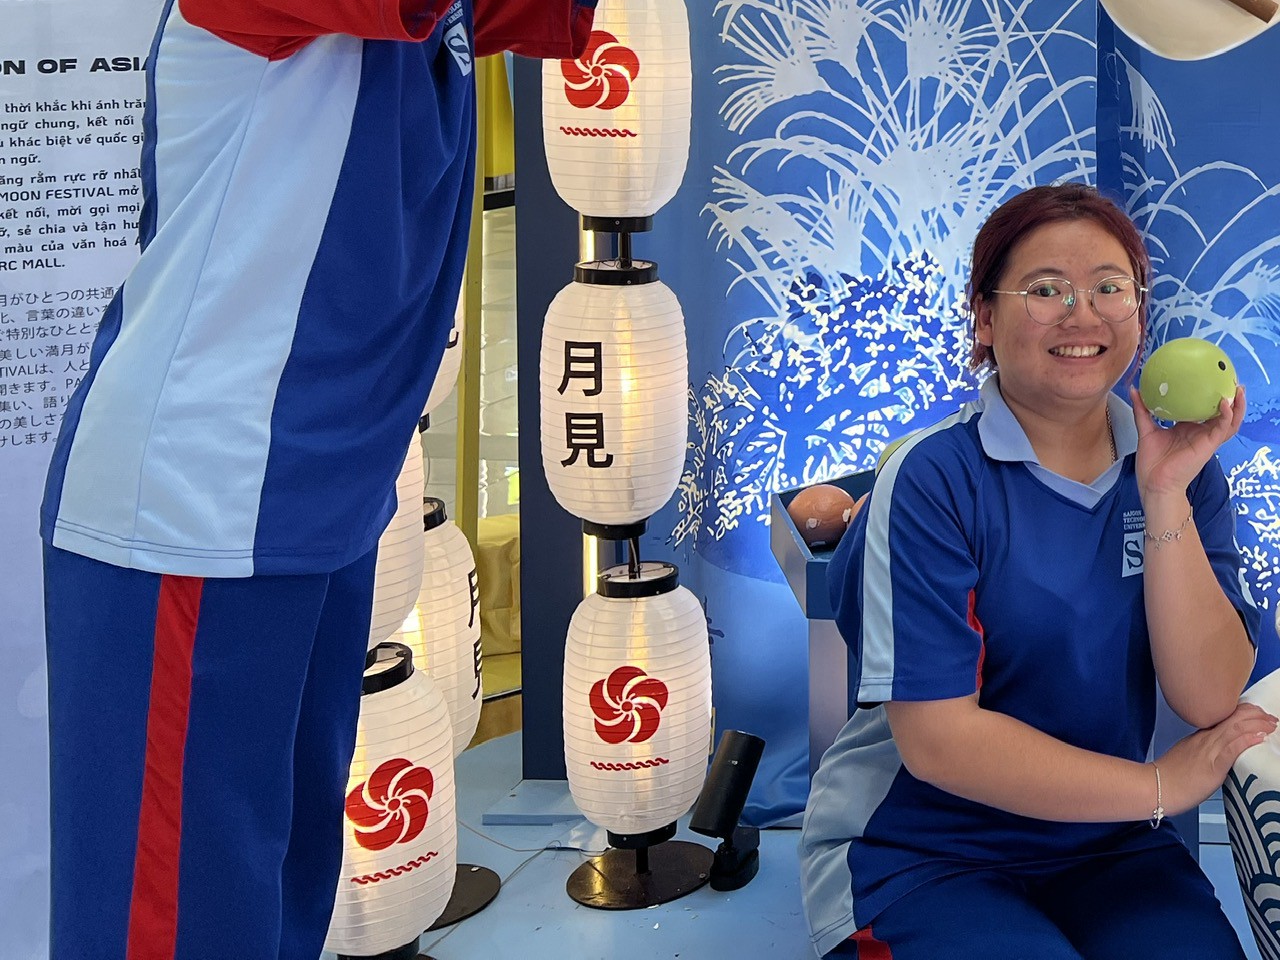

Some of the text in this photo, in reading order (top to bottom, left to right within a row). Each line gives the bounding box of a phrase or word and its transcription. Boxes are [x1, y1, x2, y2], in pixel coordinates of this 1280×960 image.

[37, 58, 78, 75] OF
[4, 102, 32, 113] thời
[36, 99, 67, 112] khắc
[71, 100, 92, 111] khi
[96, 99, 120, 110] ánh
[1, 115, 135, 133] ngữ chung, kết nối
[9, 136, 41, 148] khác
[46, 135, 72, 148] biệt
[96, 132, 128, 146] quốc
[10, 154, 42, 167] ngữ.
[45, 184, 140, 201] FESTIVAL mở
[26, 202, 141, 220] nối, mời gọi mọi
[38, 223, 66, 235] chia
[72, 221, 89, 233] và
[95, 220, 117, 233] tận
[4, 236, 128, 255] màu của văn hoá
[22, 257, 66, 271] MALL.
[557, 340, 614, 468] 月見
